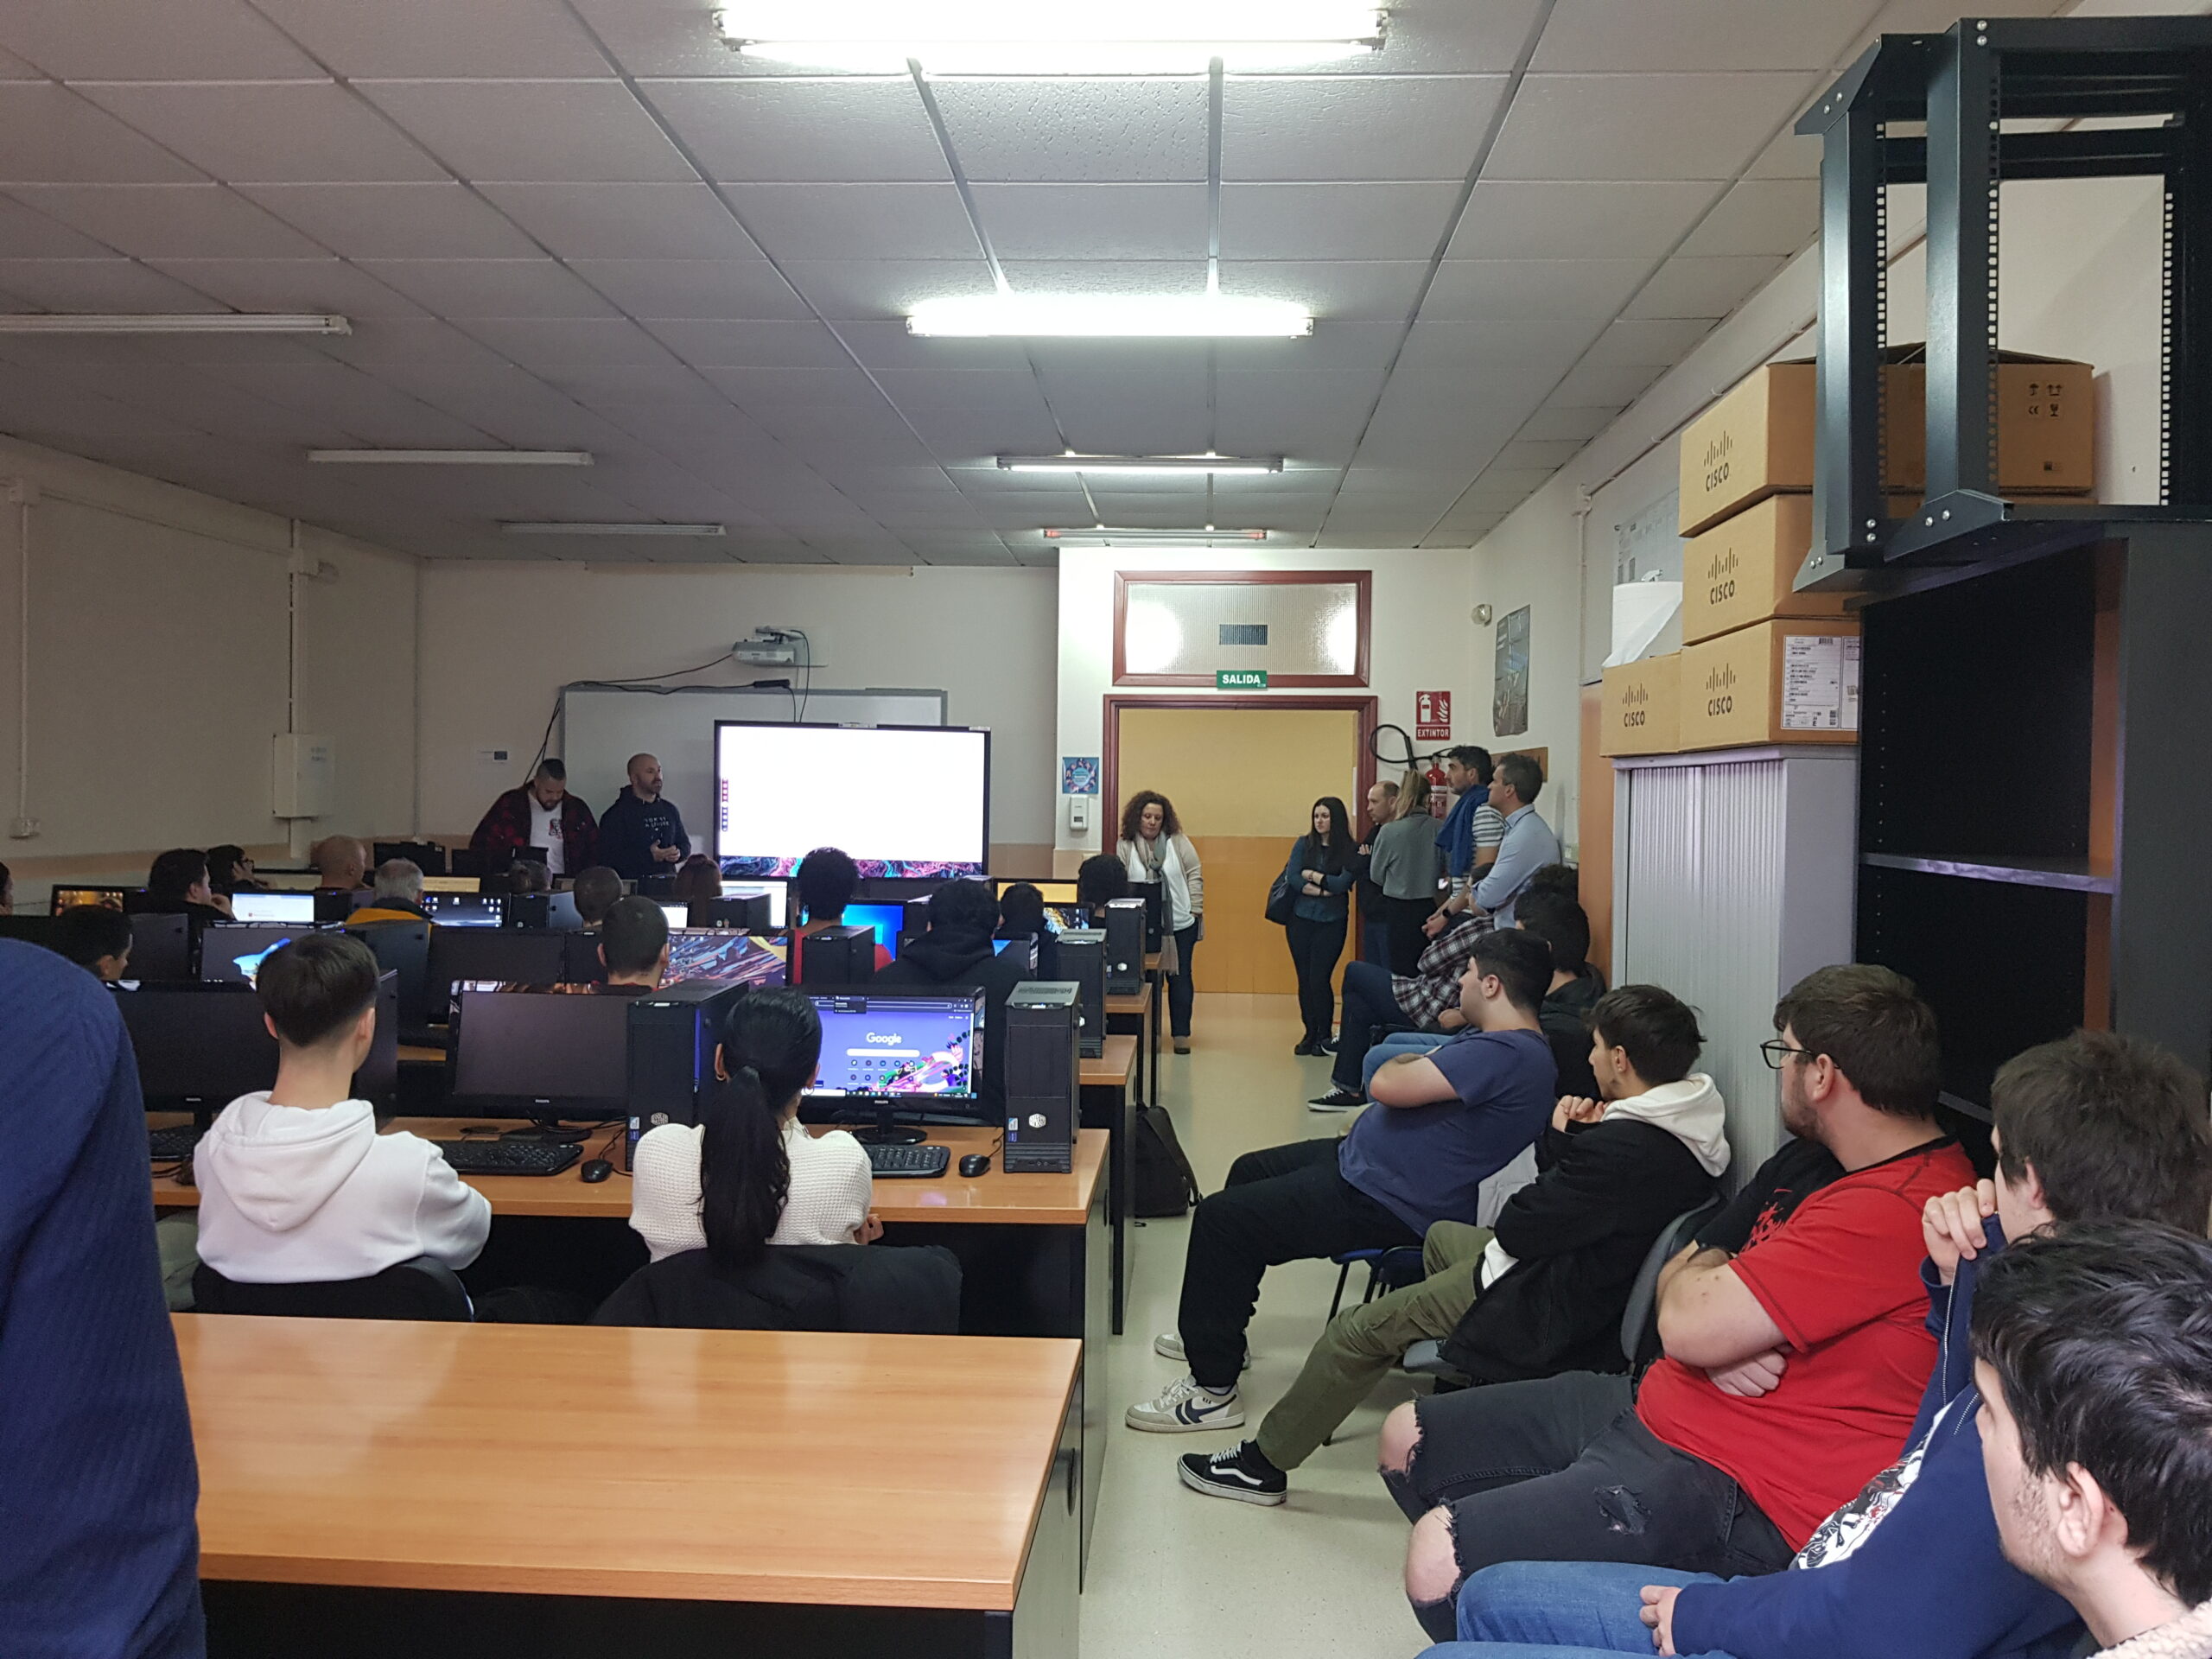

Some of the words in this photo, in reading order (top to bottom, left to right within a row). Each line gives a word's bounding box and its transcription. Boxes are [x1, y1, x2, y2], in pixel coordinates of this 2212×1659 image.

[1706, 462, 1730, 492] CISCO
[1710, 580, 1735, 605] CISCO
[1223, 674, 1261, 683] SALIDA
[1708, 696, 1732, 717] CISCO
[1624, 710, 1646, 728] CISCO
[1418, 728, 1449, 737] EXTINTOR
[867, 1032, 902, 1046] Google
